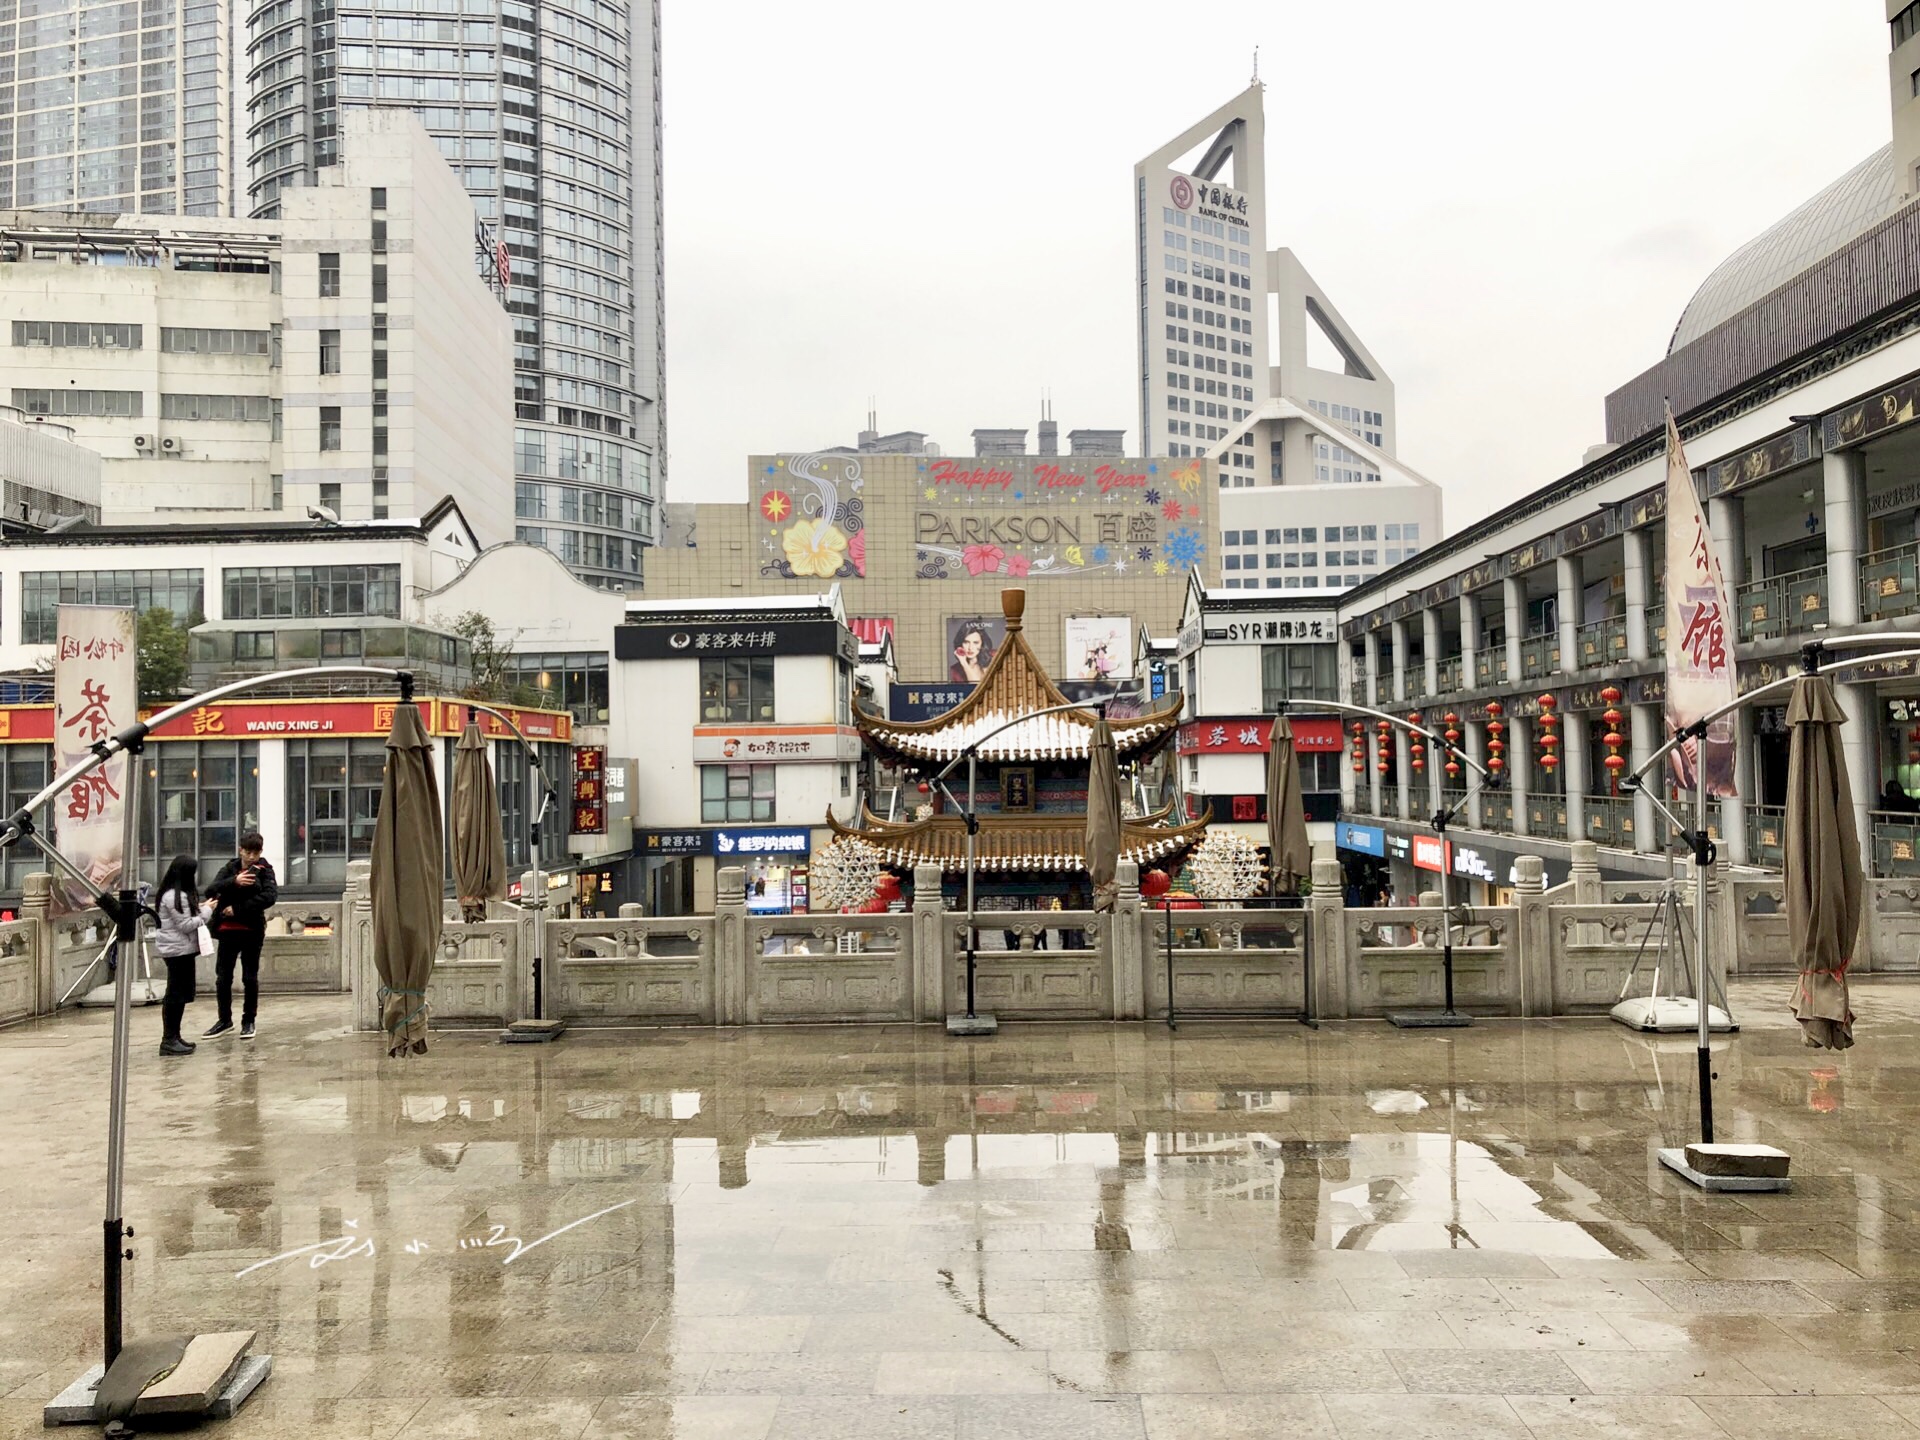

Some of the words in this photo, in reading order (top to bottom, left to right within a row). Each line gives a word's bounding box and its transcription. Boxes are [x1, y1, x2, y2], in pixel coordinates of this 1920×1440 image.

[1198, 184, 1249, 215] 中国银行
[1199, 206, 1218, 219] BANK
[1218, 212, 1228, 221] OF
[1228, 215, 1250, 228] CHINA
[930, 460, 1014, 491] Happy
[1033, 464, 1086, 489] New
[1094, 464, 1149, 494] Year
[914, 511, 1080, 544] PARKSON
[1093, 511, 1158, 543] 百盛
[695, 631, 777, 649] 豪客来牛排
[246, 721, 285, 731] WANG
[287, 720, 319, 730] XING
[321, 720, 333, 730] JI
[747, 740, 811, 755] 如意馄饨
